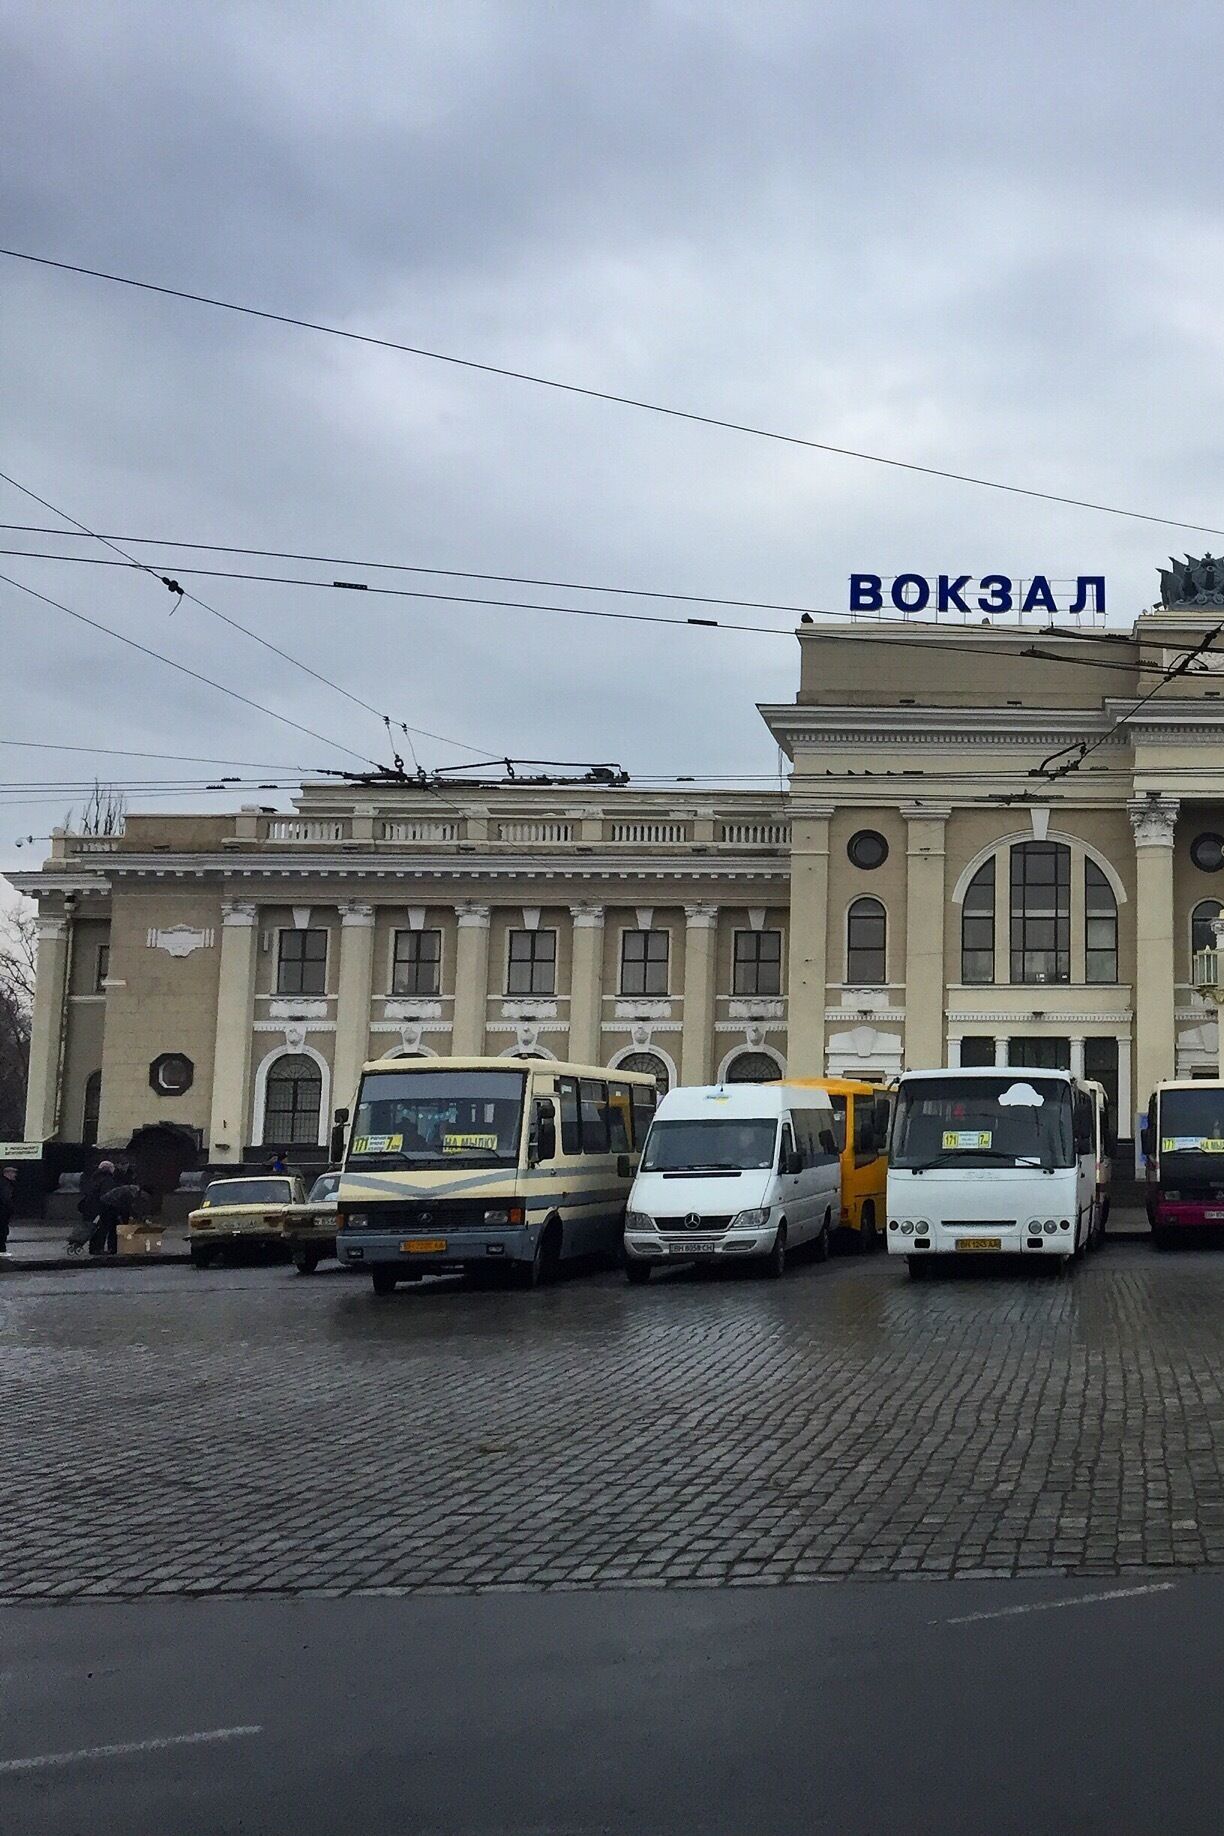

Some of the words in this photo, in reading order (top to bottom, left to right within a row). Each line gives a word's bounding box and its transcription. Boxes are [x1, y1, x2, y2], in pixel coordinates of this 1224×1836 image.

[850, 573, 1106, 613] ВОКЗАЛ
[355, 1136, 369, 1152] 171
[945, 1134, 957, 1145] 171
